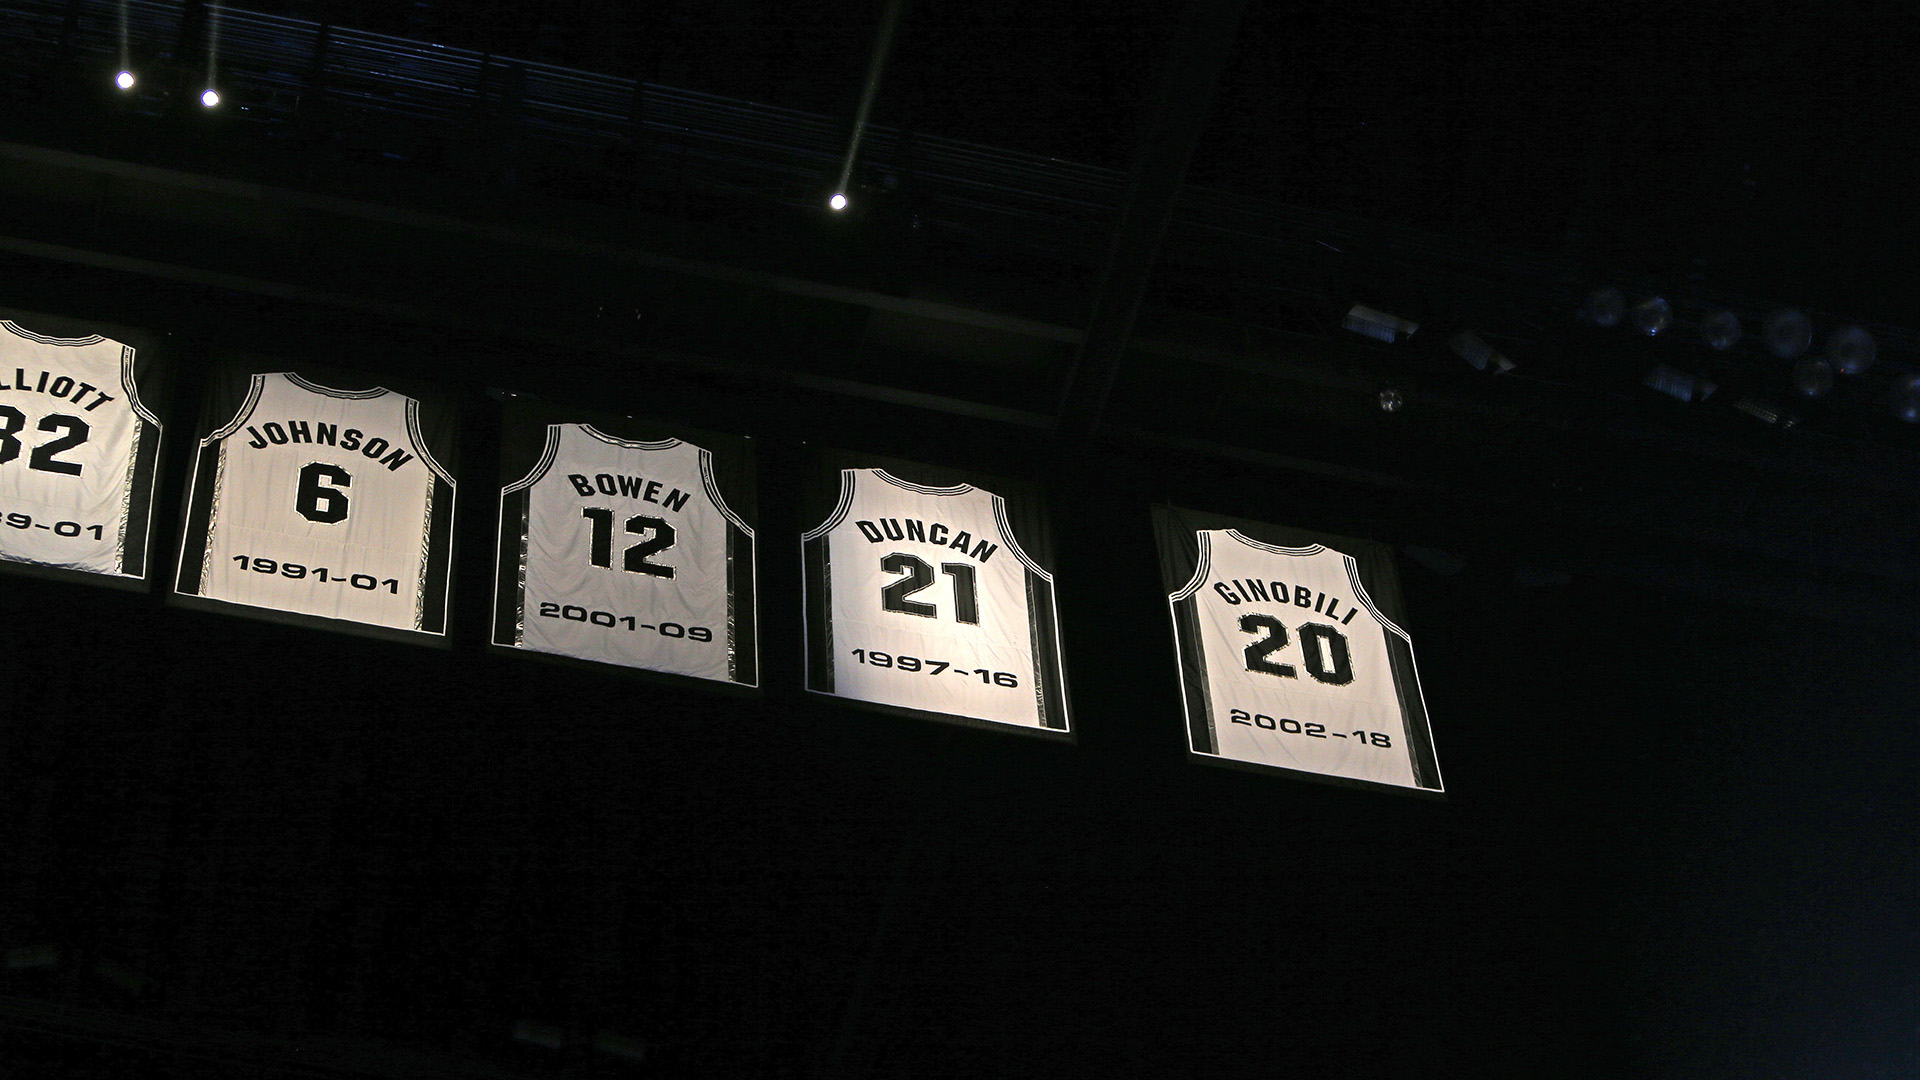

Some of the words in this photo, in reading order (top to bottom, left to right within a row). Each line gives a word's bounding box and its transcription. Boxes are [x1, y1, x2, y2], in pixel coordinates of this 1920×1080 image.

[246, 421, 414, 471] JOHNSON
[294, 460, 352, 524] 6
[568, 474, 691, 512] BOWEN
[0, 512, 103, 540] 9-01
[580, 507, 675, 580] 12
[855, 519, 998, 563] DUNCAN
[233, 555, 398, 594] 1991-01
[881, 552, 986, 624] 21
[540, 602, 712, 642] 2001-09
[1213, 579, 1358, 625] GINOBILI
[852, 649, 1017, 688] 1997-16
[1238, 613, 1354, 686] 20
[1231, 709, 1391, 748] 2002-18
